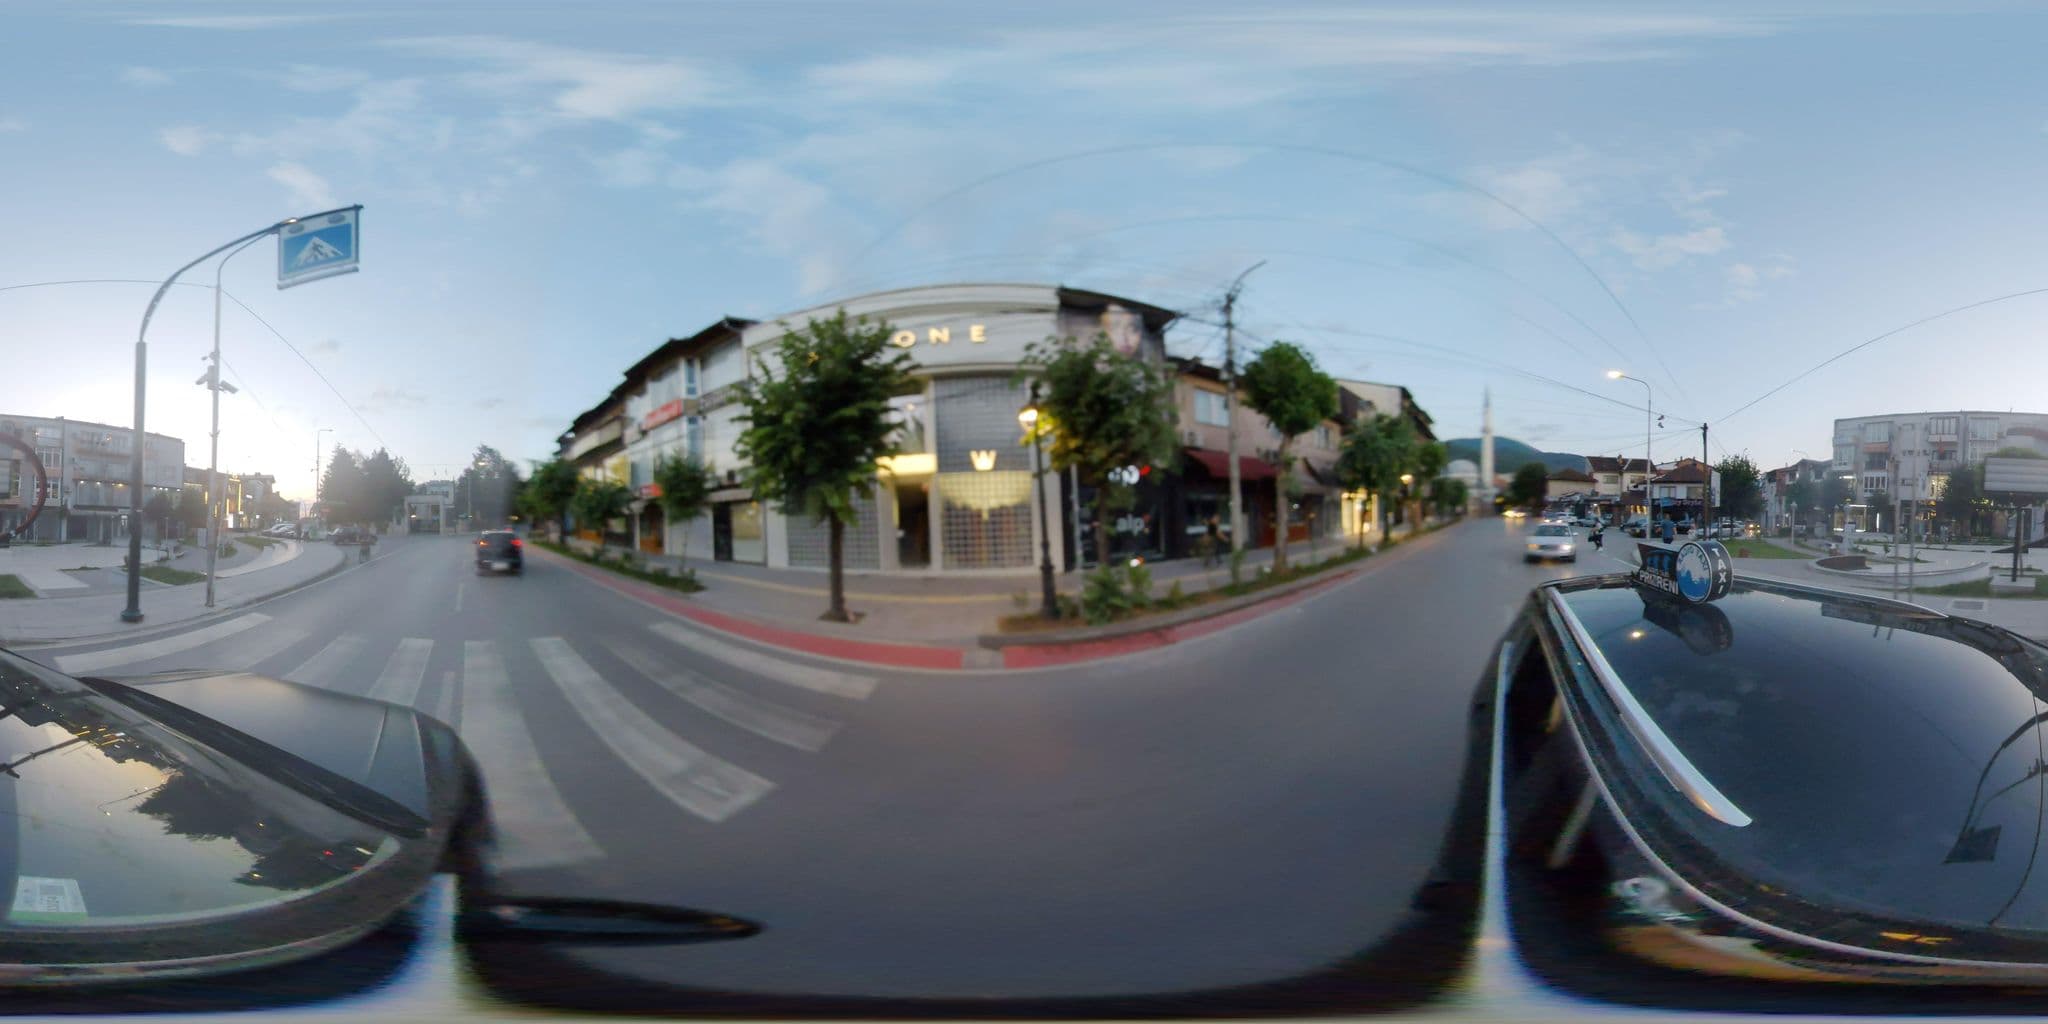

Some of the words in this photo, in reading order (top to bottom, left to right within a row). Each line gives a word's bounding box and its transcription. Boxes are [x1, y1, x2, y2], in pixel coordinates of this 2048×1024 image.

[970, 449, 997, 471] W
[1639, 569, 1679, 595] PRIZRENI
[1711, 548, 1727, 594] TAXI
